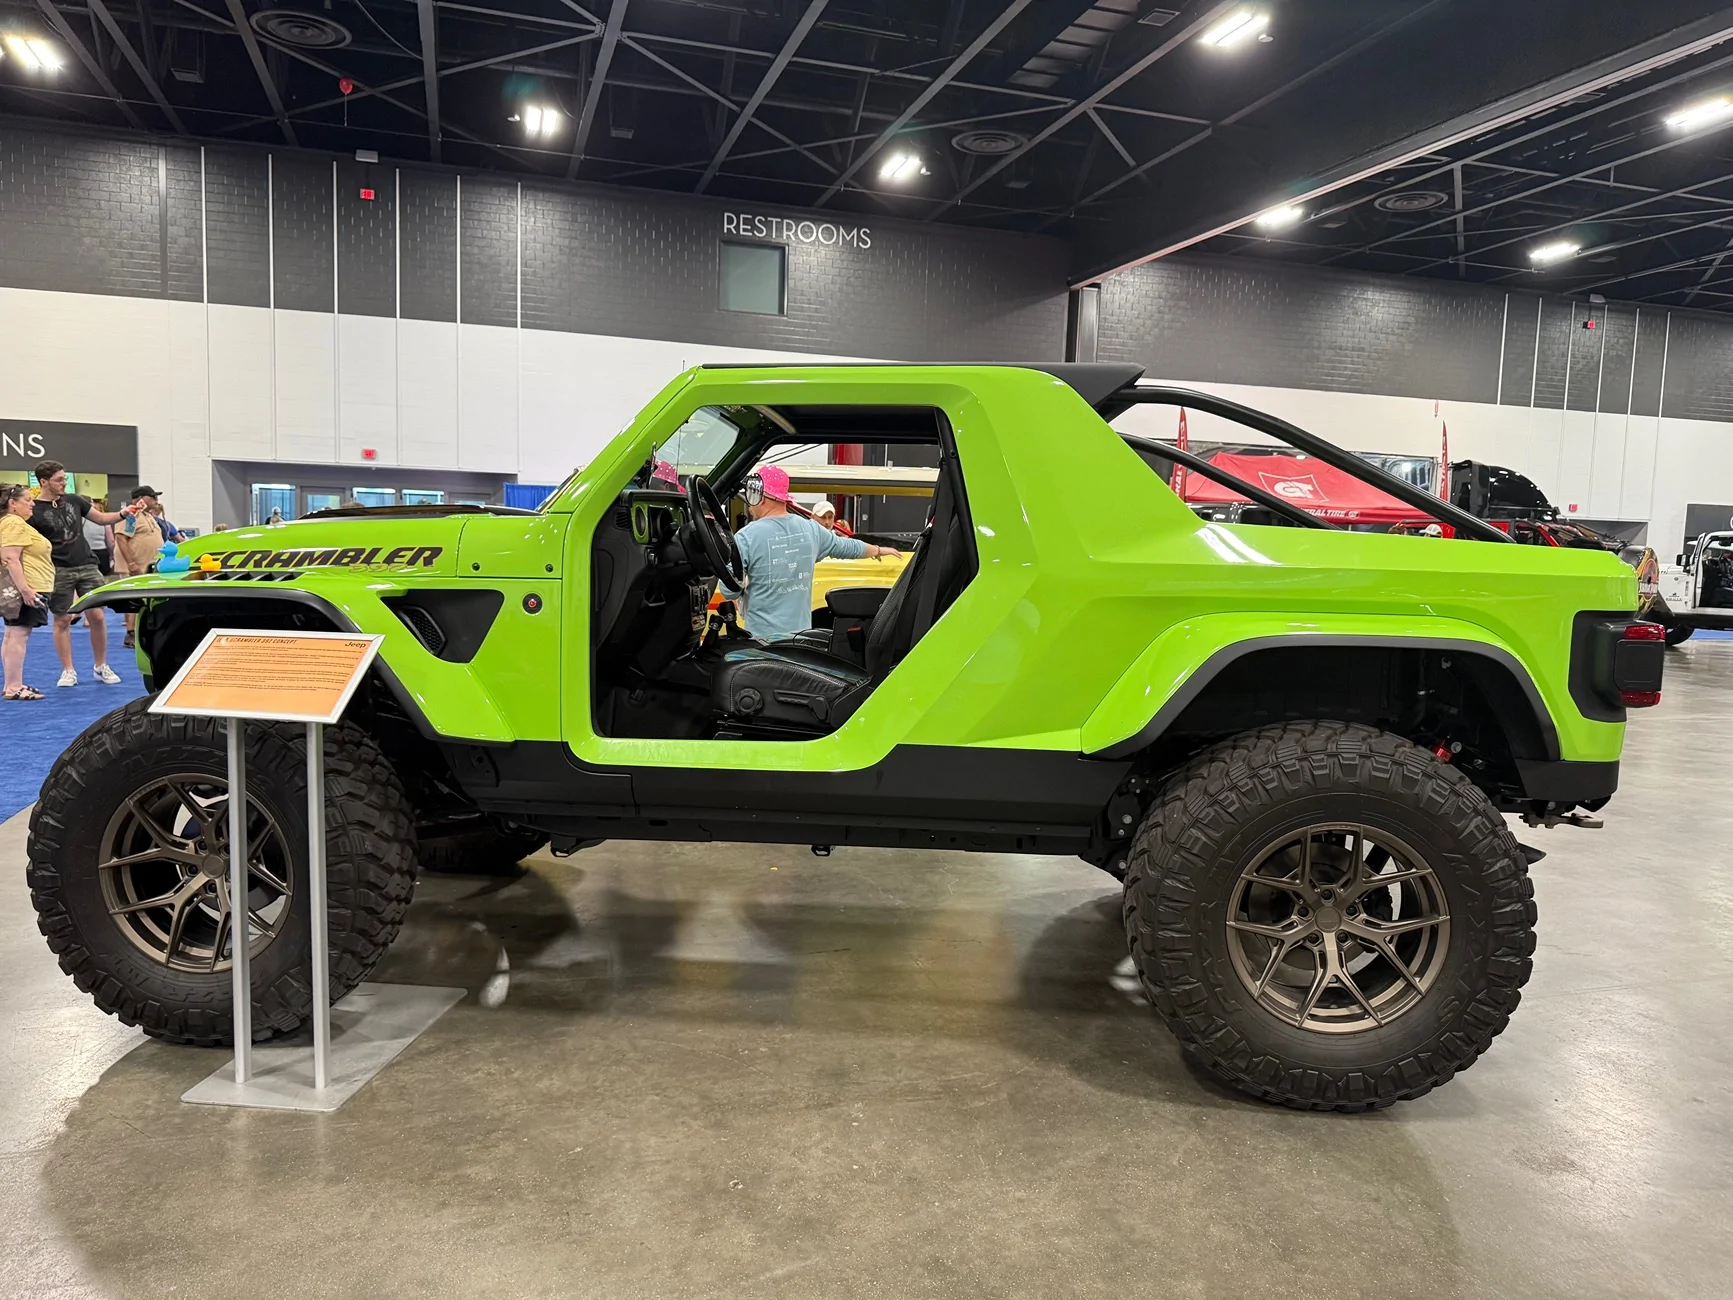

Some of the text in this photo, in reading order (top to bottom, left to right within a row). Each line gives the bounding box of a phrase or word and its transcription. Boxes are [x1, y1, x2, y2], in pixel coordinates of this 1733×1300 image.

[723, 212, 872, 250] RESTROOMS
[2, 432, 46, 458] NS
[189, 546, 444, 570] SCRAMBLER
[349, 562, 408, 574] 392
[344, 641, 367, 649] Jeep
